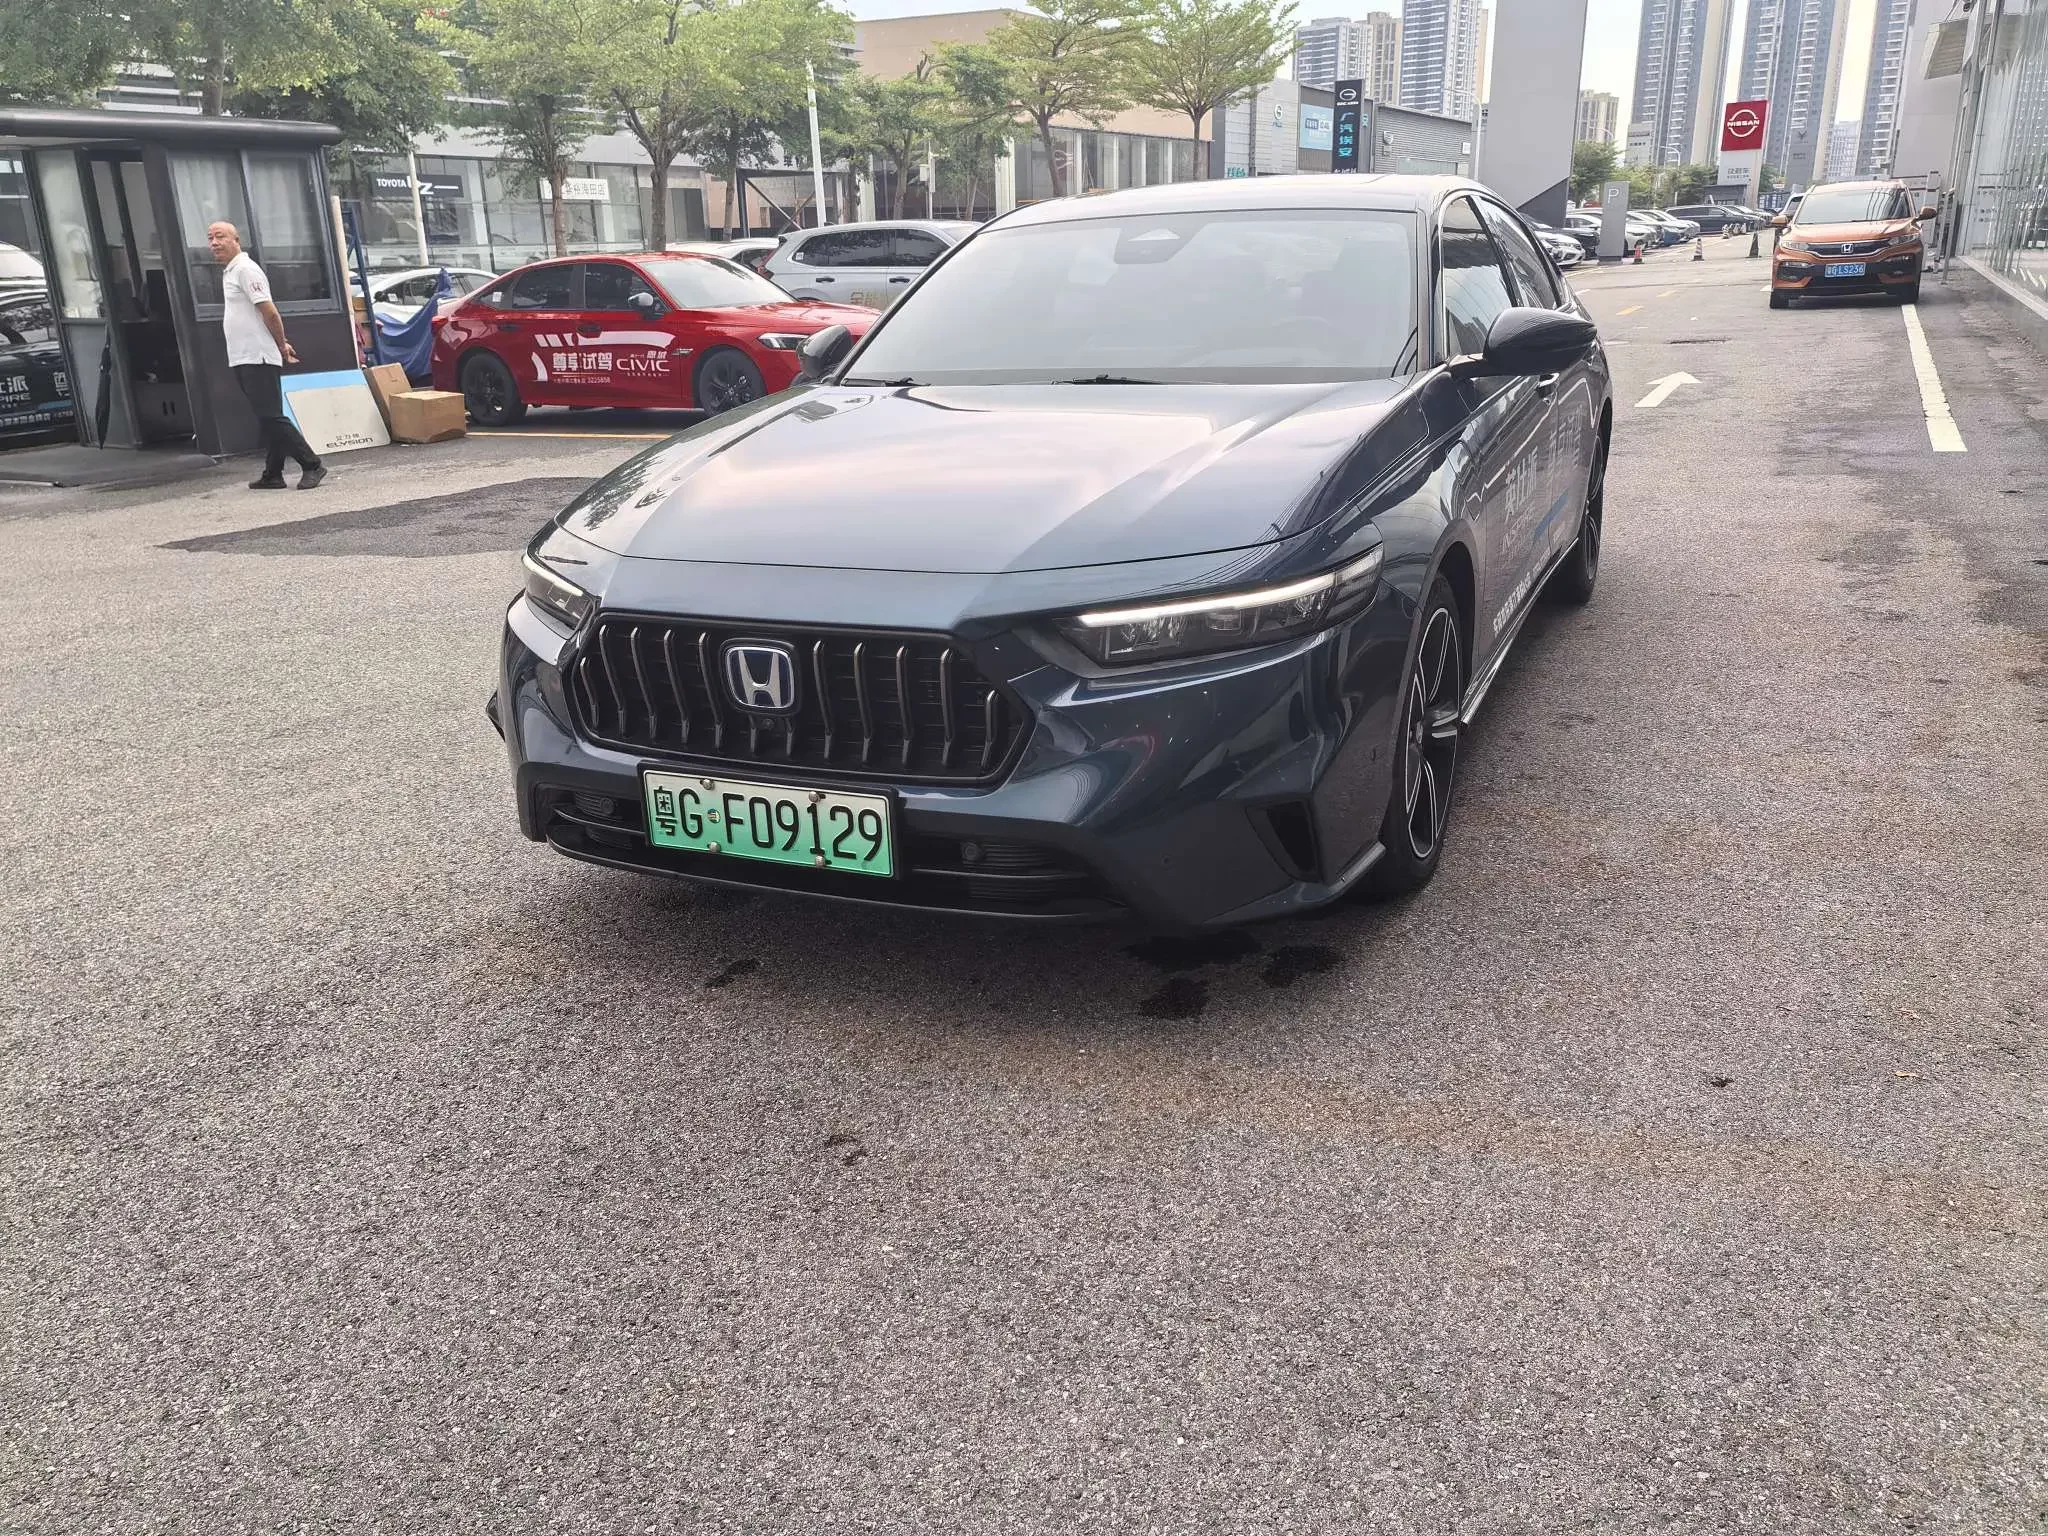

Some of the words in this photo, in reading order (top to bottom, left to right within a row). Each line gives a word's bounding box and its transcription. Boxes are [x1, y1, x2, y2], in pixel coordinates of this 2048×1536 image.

[376, 178, 407, 188] TOYOTA
[616, 358, 671, 372] CIVIC
[326, 437, 374, 449] ELYSION
